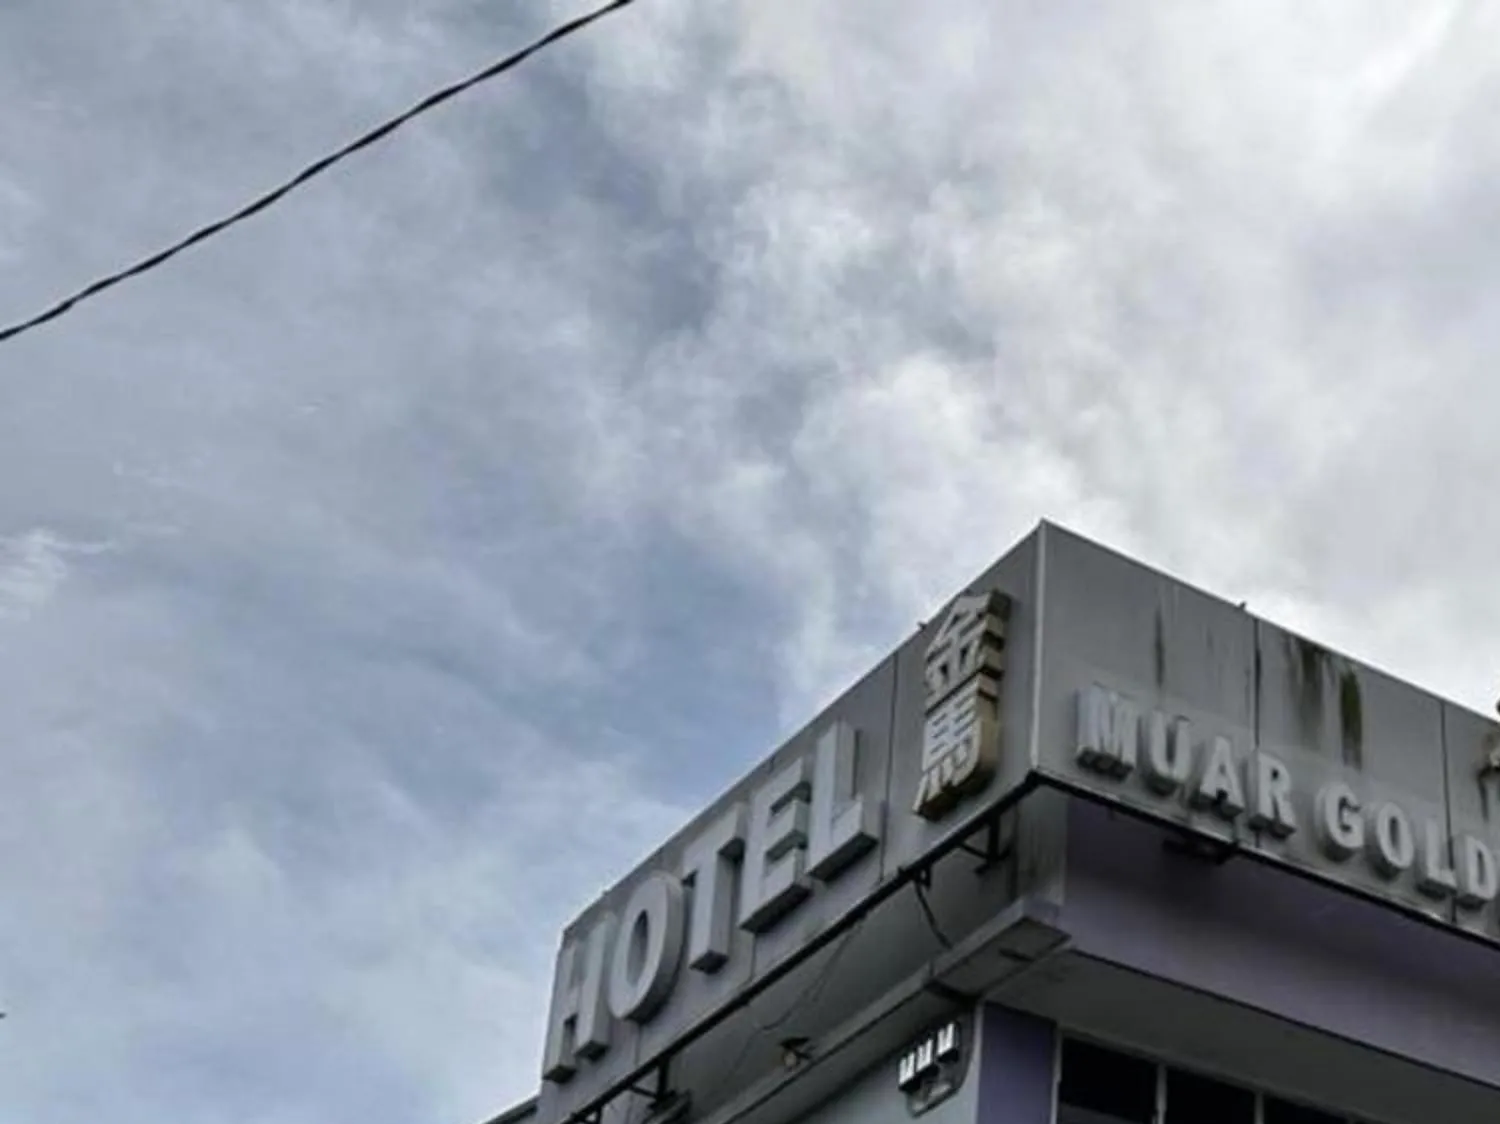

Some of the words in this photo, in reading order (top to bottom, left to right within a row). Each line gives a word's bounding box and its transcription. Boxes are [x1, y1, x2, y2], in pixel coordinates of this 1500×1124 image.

[912, 590, 1010, 820] 金馬
[1075, 684, 1296, 839] MUAR
[541, 720, 879, 1083] HOTEL
